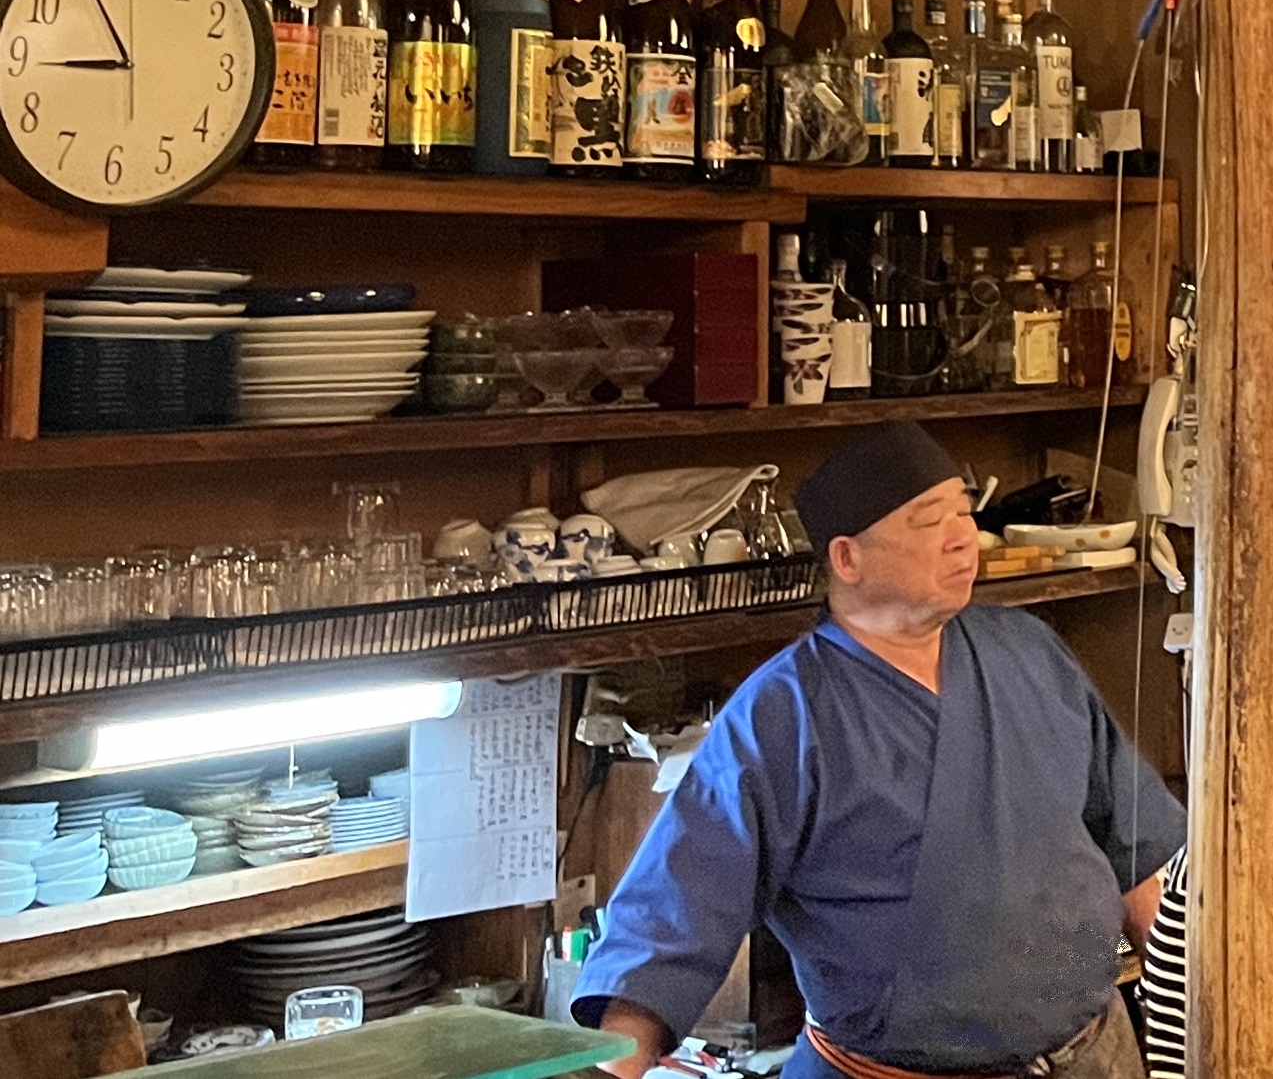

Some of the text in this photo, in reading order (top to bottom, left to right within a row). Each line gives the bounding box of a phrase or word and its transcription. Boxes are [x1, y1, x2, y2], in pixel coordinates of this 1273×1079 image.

[207, 1, 226, 39] 2
[8, 36, 28, 77] 9
[216, 53, 235, 92] 3
[20, 91, 40, 134] 8
[404, 83, 474, 112] いいち
[193, 104, 210, 143] 4
[56, 131, 77, 171] 7
[104, 145, 124, 186] 6
[154, 135, 174, 175] 5
